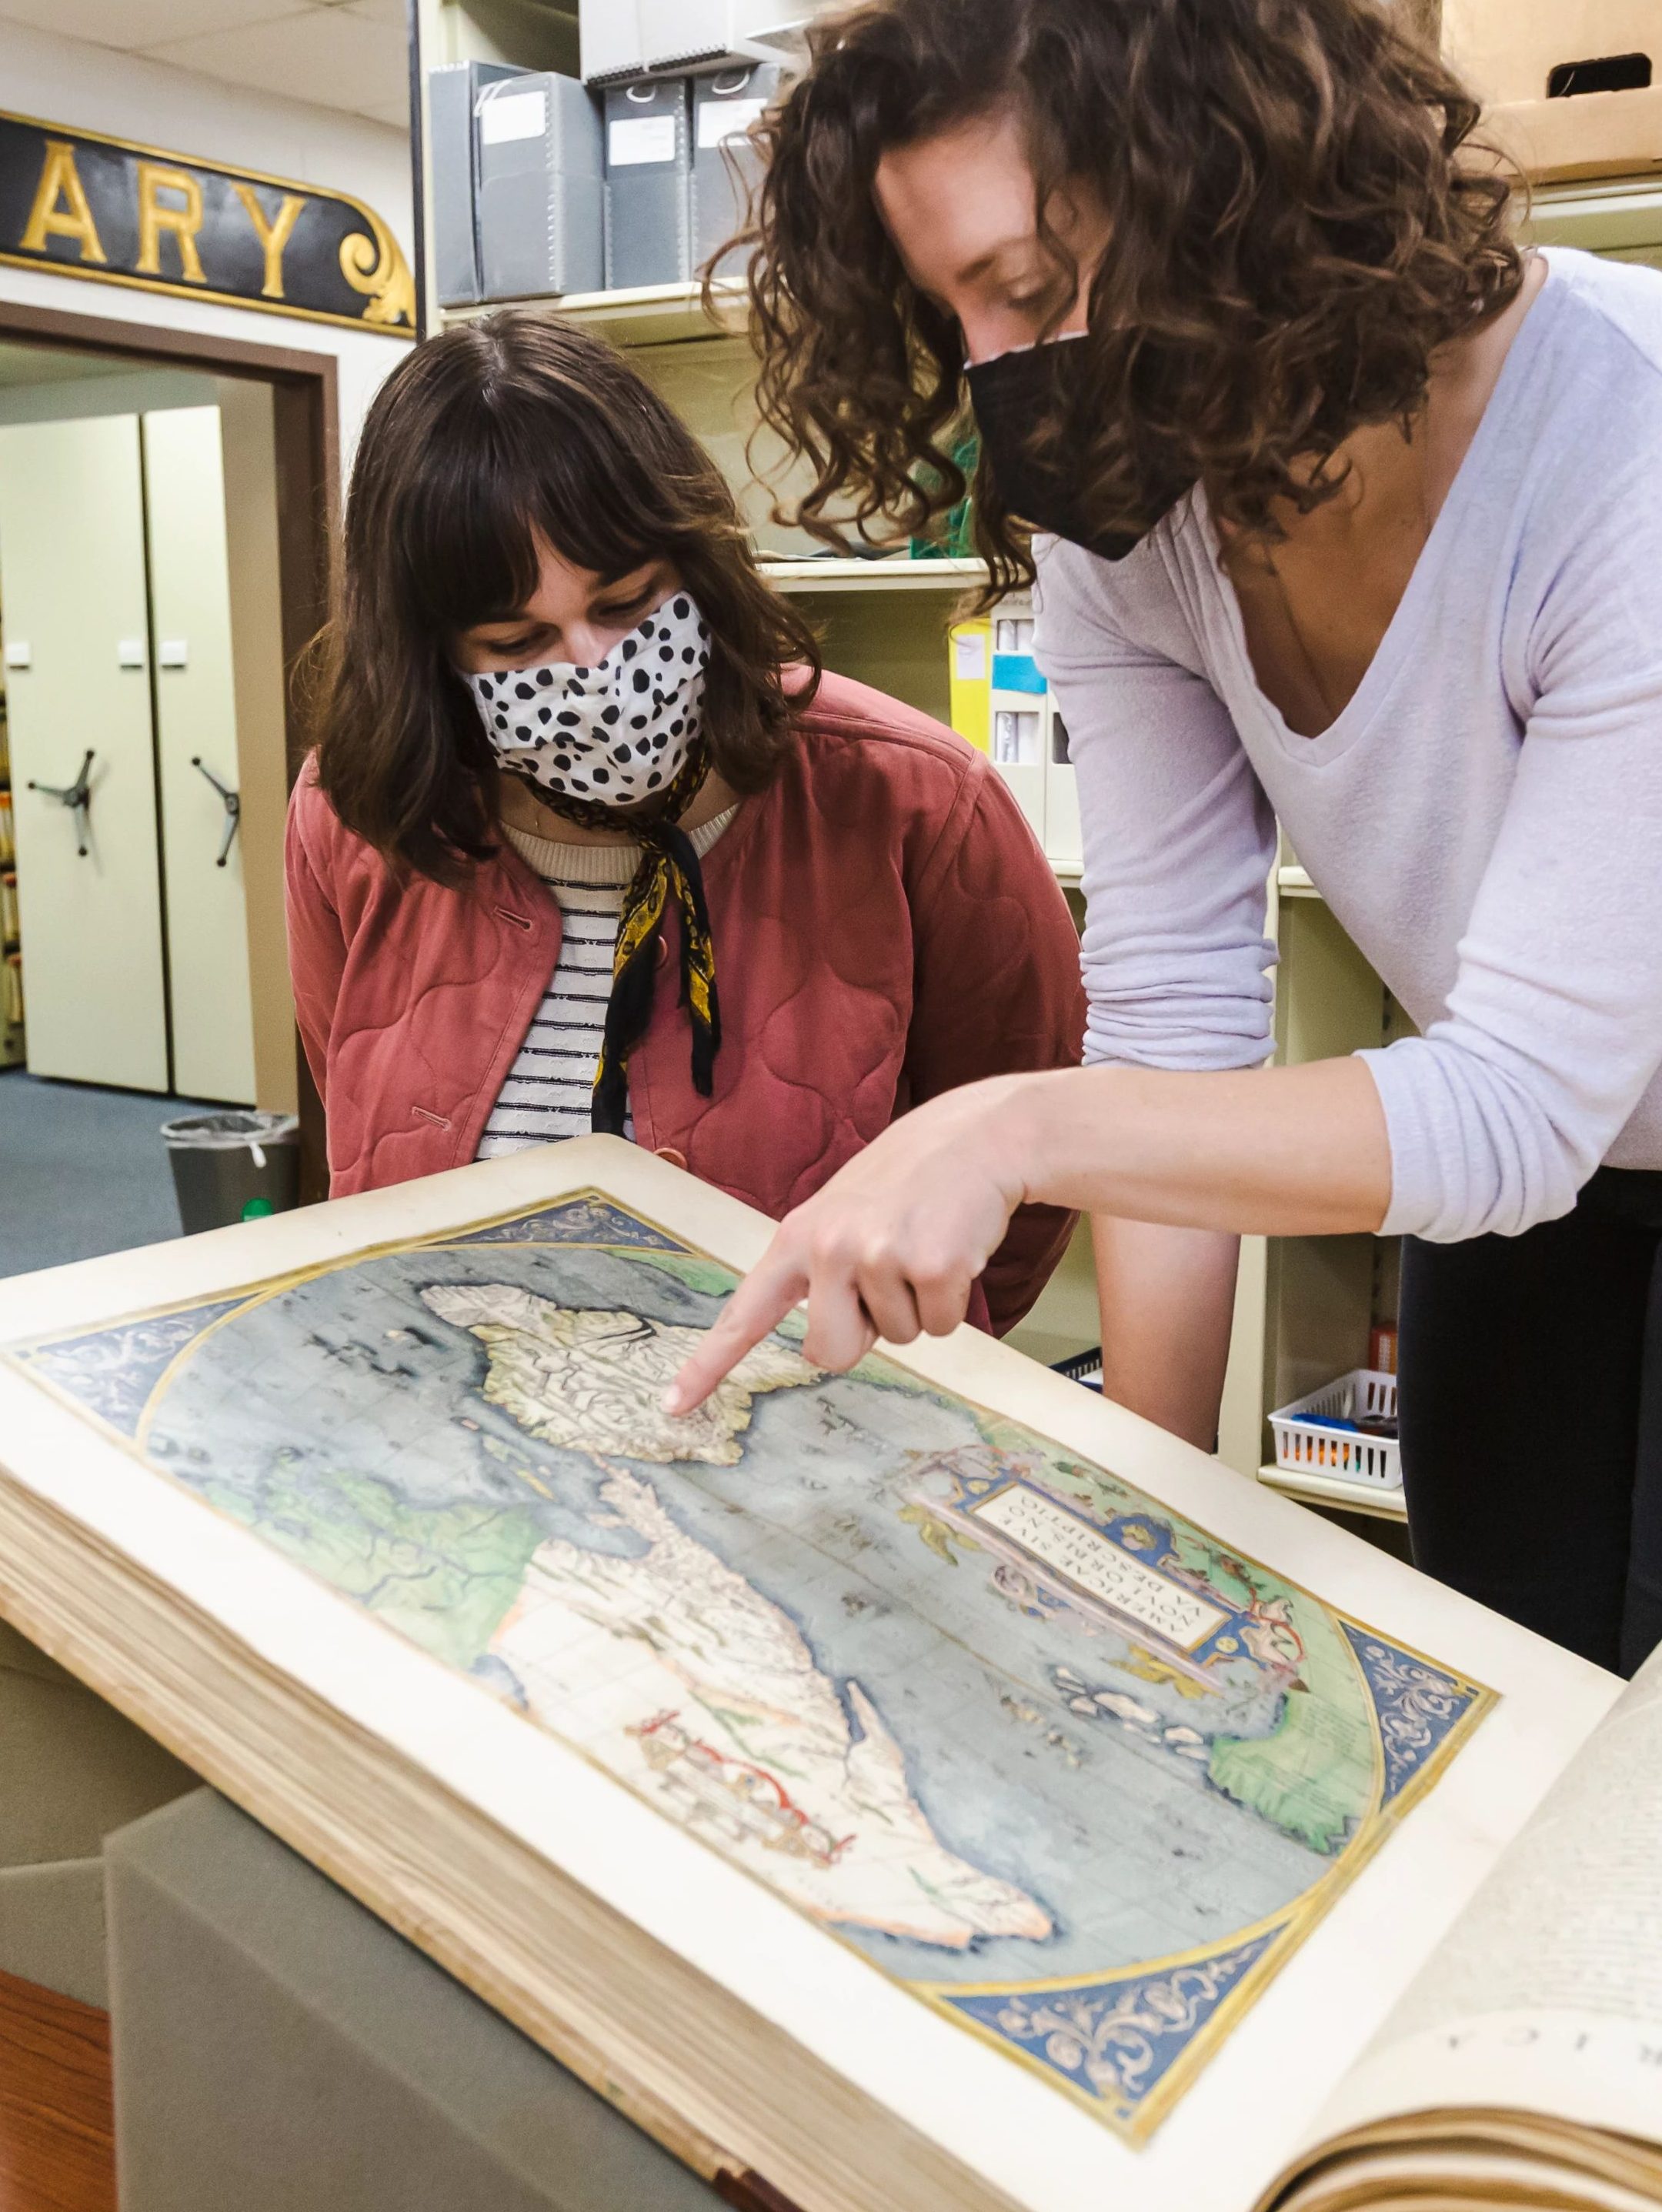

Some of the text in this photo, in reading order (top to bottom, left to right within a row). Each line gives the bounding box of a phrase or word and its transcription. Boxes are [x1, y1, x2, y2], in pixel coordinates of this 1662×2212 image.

[19, 139, 307, 298] ARY
[999, 1516, 1184, 1633] AMERICAE SIVE
[1021, 1495, 1163, 1593] DESCRIPTIO
[1133, 1587, 1196, 1627] NOVI
